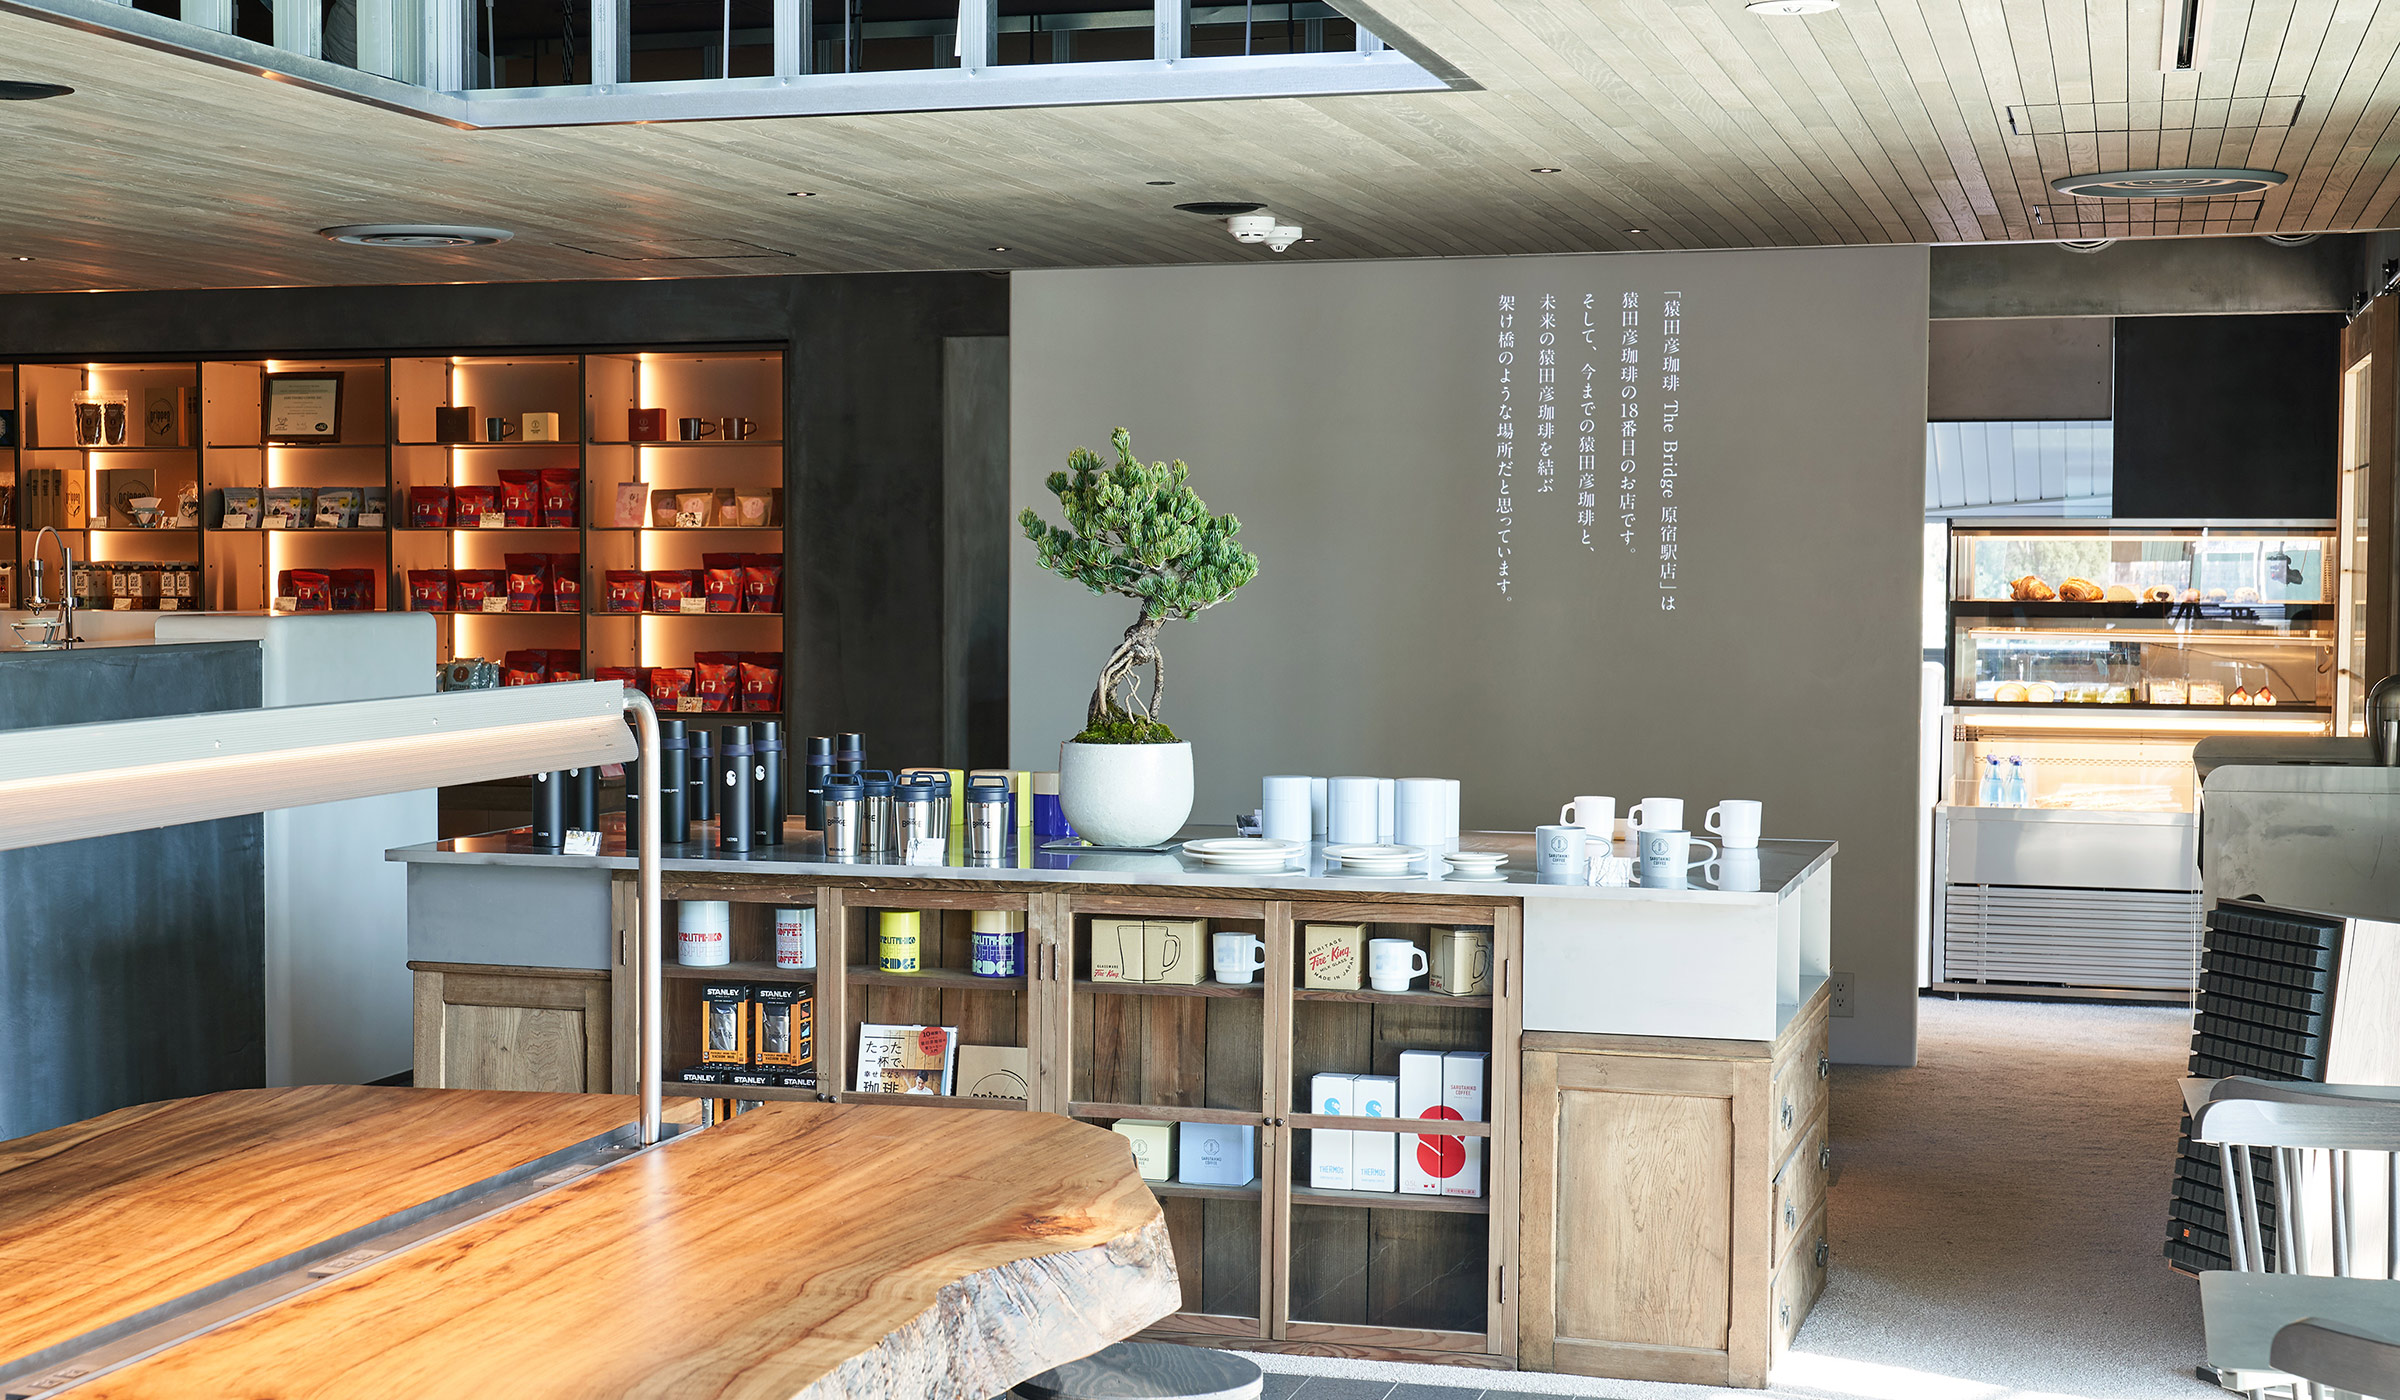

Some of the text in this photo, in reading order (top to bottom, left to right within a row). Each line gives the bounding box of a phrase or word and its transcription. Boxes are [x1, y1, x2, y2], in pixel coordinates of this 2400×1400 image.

[1537, 293, 1556, 493] 未来の猿田彦珈琲を結ぶ
[1620, 291, 1639, 554] 猿田彦珈琲の18番目のお店です。
[1495, 294, 1515, 602] 架け橋のような場所だと思っています。
[1659, 291, 1681, 611] 「猿田彦珈琲 The Bridge 原宿駅店」は
[1308, 937, 1343, 956] HERITAGE
[1332, 958, 1348, 967] GLASS
[1314, 971, 1331, 982] MADE
[1343, 956, 1355, 976] JAPAN
[706, 988, 740, 996] STANLEY
[760, 990, 793, 998] STANLEY
[865, 1041, 902, 1055] たった
[865, 1056, 906, 1069] 一杯で、
[683, 1074, 716, 1082] STANLEY
[864, 1070, 901, 1079] 幸せになる
[734, 1076, 766, 1085] STANLEY
[784, 1078, 816, 1087] STANLEY
[863, 1081, 900, 1094] 珈琲
[1319, 1165, 1344, 1175] THERMOS
[1361, 1167, 1386, 1177] THERMOS
